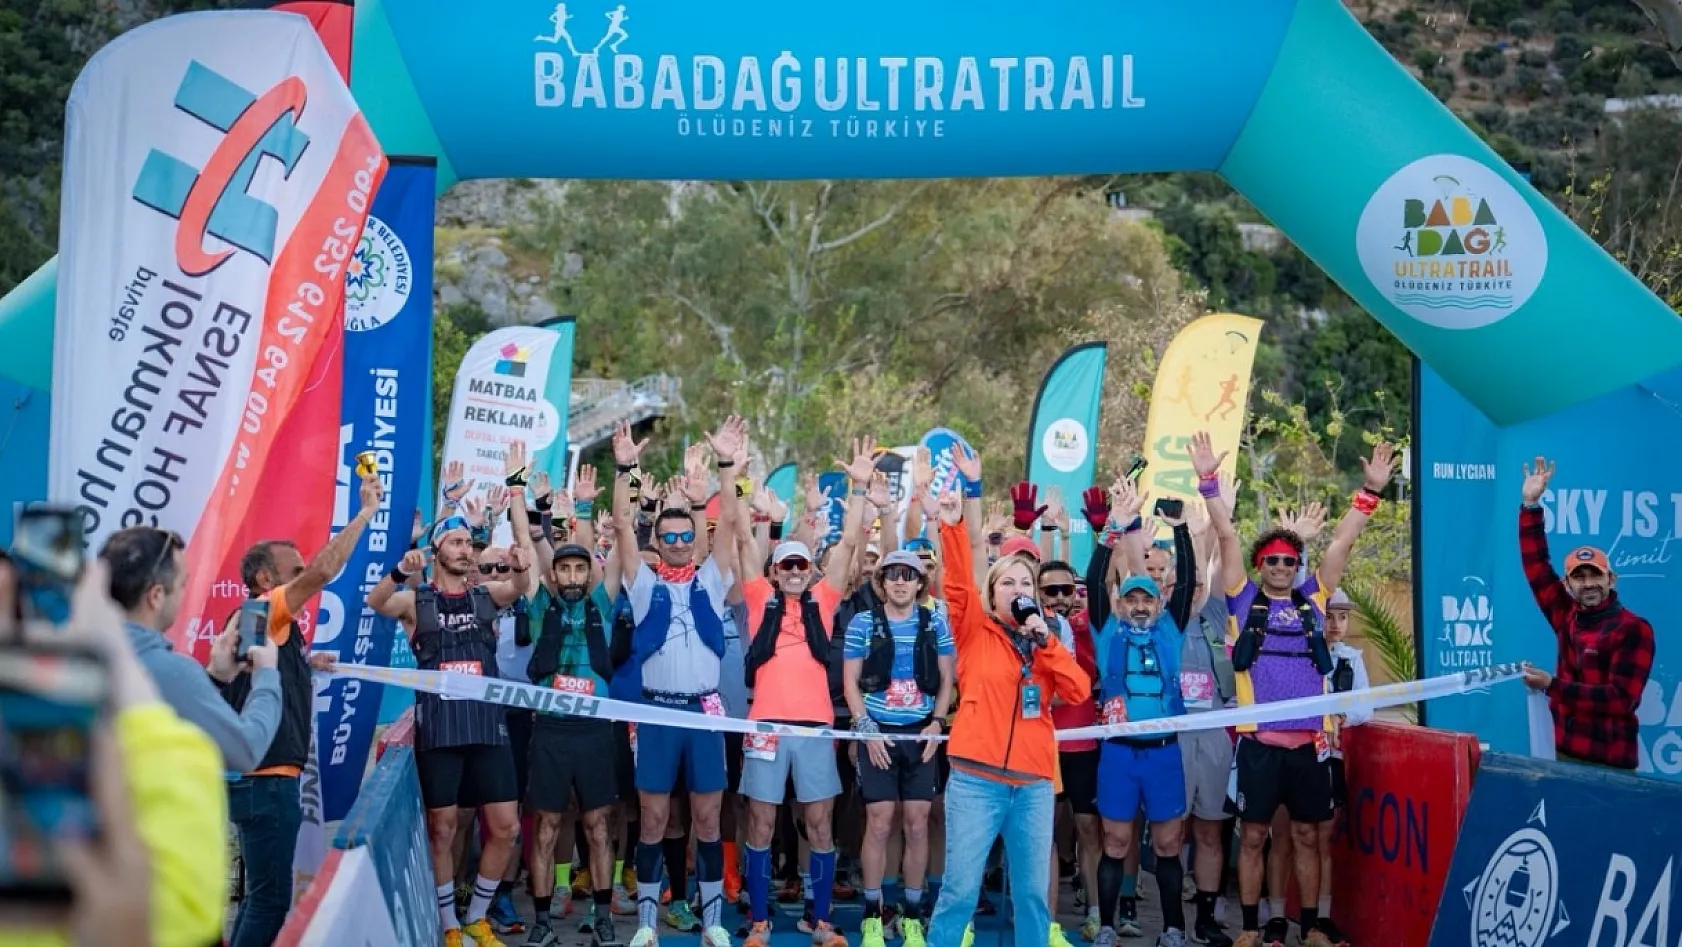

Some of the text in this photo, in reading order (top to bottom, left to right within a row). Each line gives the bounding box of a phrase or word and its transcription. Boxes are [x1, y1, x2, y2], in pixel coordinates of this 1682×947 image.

[677, 118, 945, 138] ÖLÜDENİZ TÜRKİYE
[1404, 196, 1497, 228] BABA
[1394, 259, 1513, 279] ULTRATRAIL
[468, 377, 538, 402] MATBAA
[464, 405, 534, 430] REKLAM
[1433, 461, 1496, 480] RUN LYCIAN
[1538, 488, 1608, 535] SKY
[1621, 490, 1660, 538] IS
[483, 682, 600, 716] FINISH
